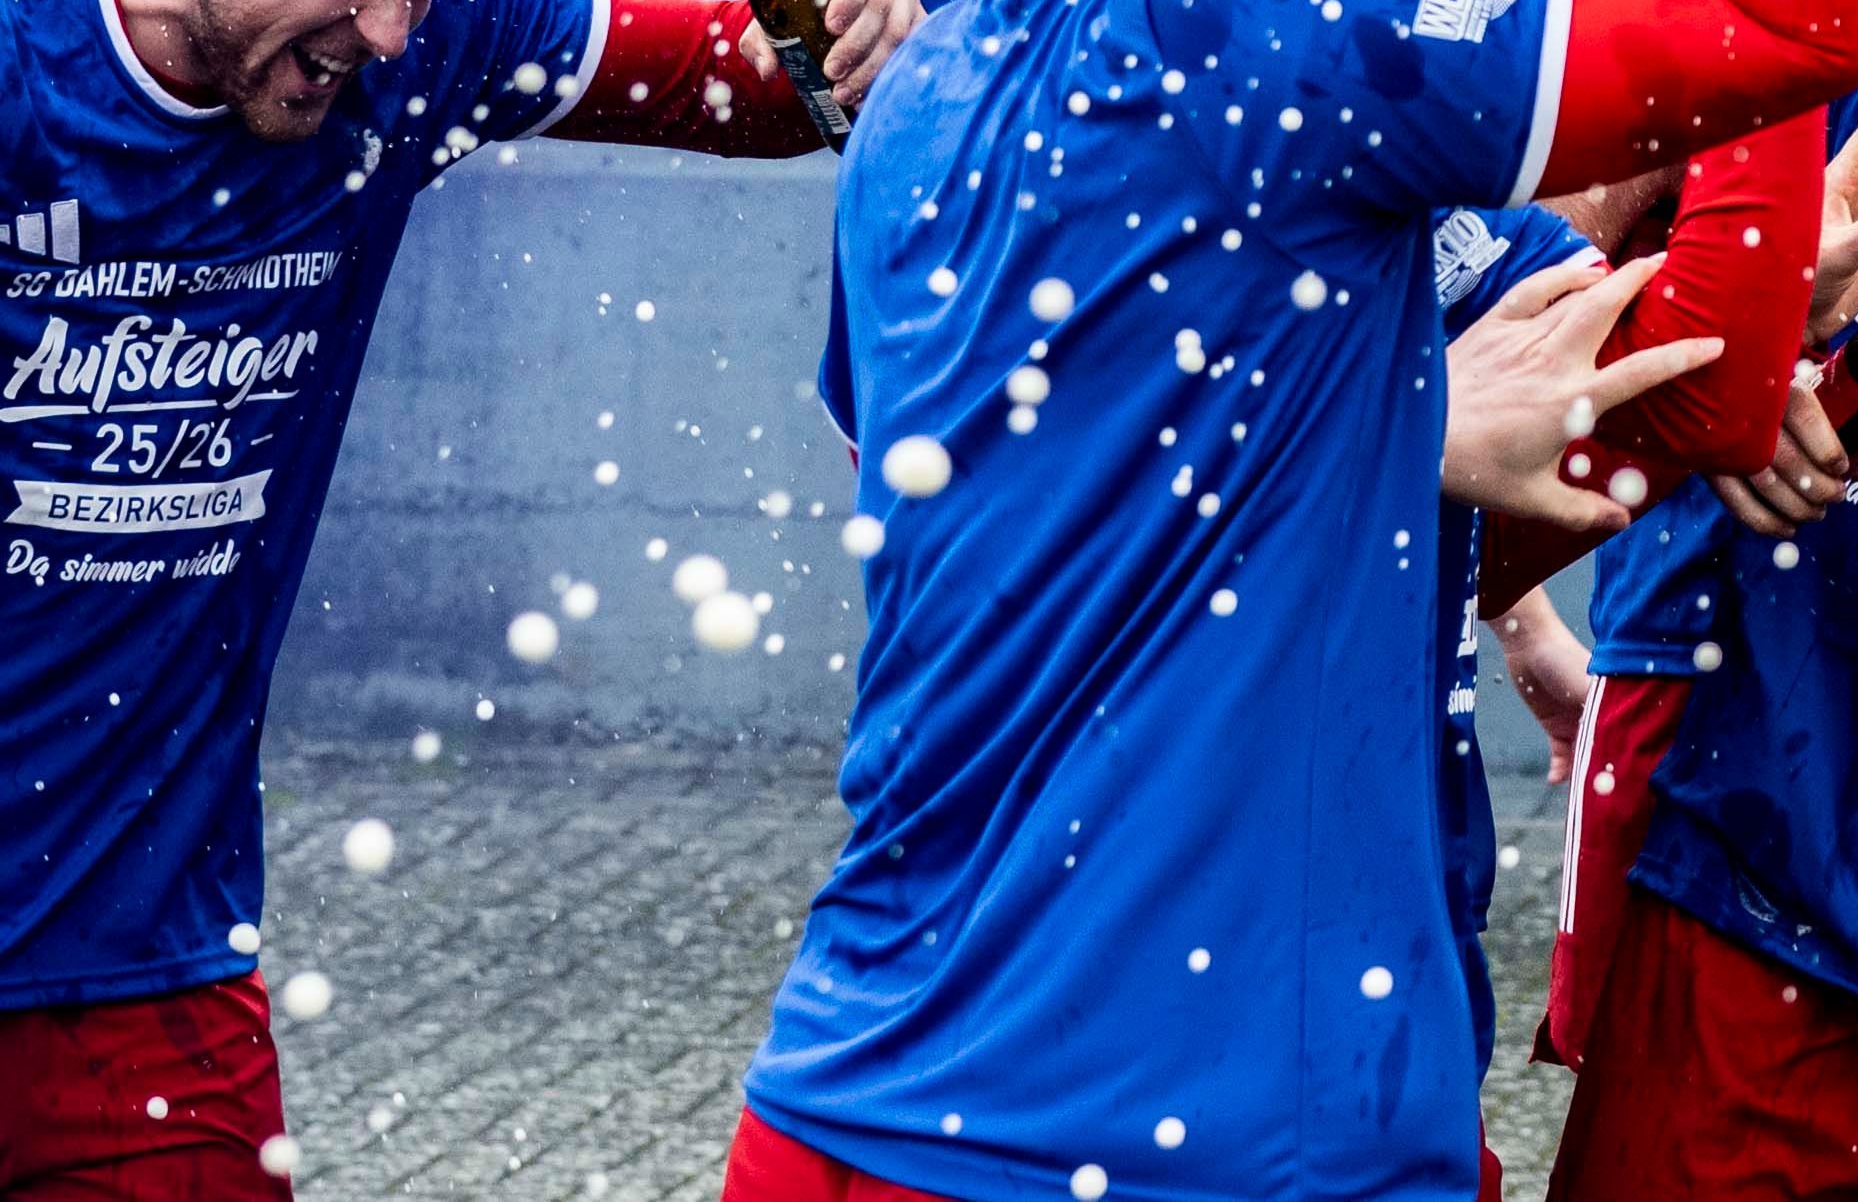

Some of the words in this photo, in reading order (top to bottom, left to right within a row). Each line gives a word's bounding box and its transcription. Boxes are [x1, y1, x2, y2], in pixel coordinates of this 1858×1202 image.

[6, 271, 52, 298] SG
[4, 315, 318, 413] Aufsteiger
[91, 418, 232, 478] 25/26
[48, 488, 243, 523] BEZIRKSLIGA
[6, 539, 50, 578] Da
[60, 554, 165, 583] simmer
